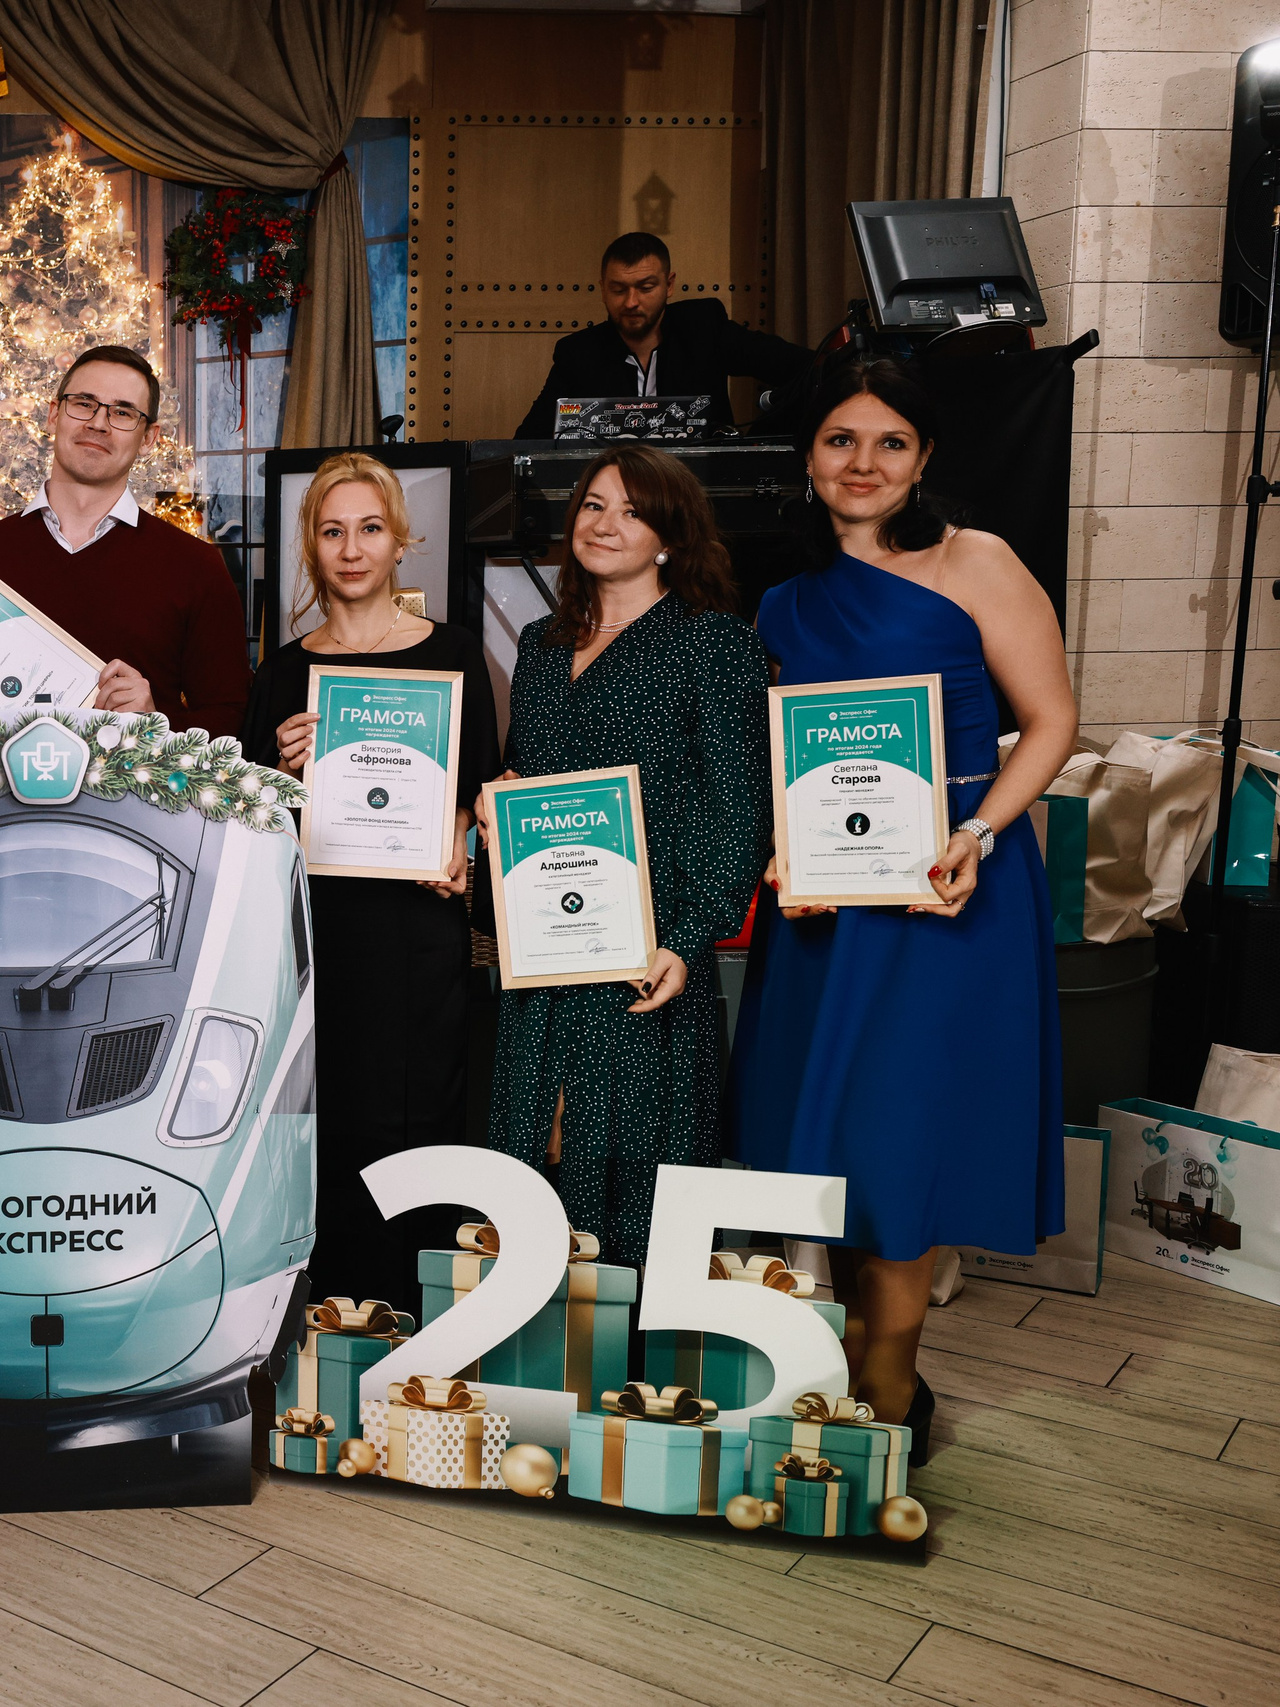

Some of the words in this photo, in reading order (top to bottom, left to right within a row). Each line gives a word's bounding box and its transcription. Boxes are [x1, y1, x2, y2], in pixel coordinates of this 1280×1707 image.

[925, 236, 980, 247] PHILIPS
[340, 707, 427, 727] ГРАМОТА
[806, 723, 902, 744] ГРАМОТА
[361, 744, 402, 755] Виктория
[350, 753, 412, 766] Сафронова
[833, 764, 878, 773] Светлана
[831, 774, 881, 786] Старова
[521, 810, 609, 833] ГРАМОТА
[551, 850, 585, 859] Татьяна
[540, 859, 598, 871] Алдошина
[1183, 1158, 1219, 1190] 20
[1155, 1246, 1169, 1257] 20
[988, 1257, 1016, 1266] Экспресс
[1017, 1261, 1034, 1269] Офис
[1191, 1256, 1215, 1268] Экспресс
[1216, 1264, 1231, 1273] Офис
